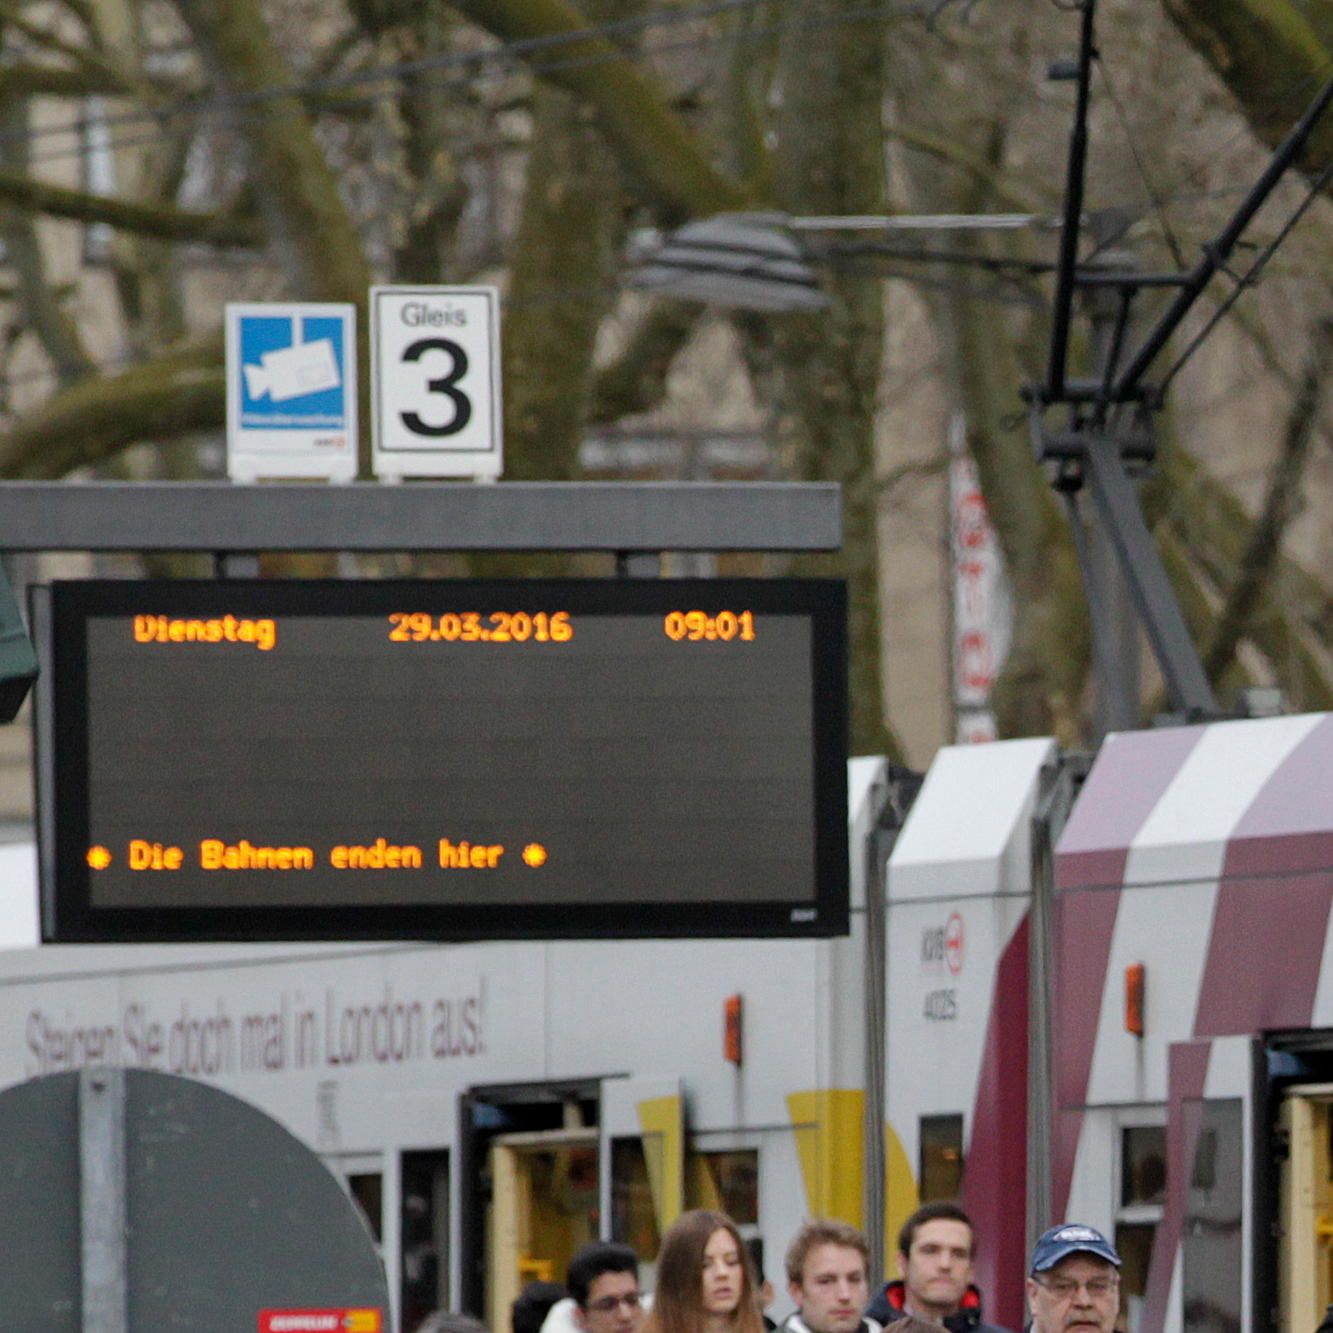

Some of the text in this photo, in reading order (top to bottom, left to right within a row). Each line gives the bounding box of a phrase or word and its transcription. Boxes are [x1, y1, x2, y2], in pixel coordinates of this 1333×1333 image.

[401, 302, 467, 326] Gleis
[399, 337, 472, 437] 3
[132, 610, 756, 651] Dienstag 29.03.2016 09:01
[128, 837, 504, 870] Die Bahnen enden hier
[168, 998, 234, 1074] doch
[240, 988, 287, 1071] mal
[293, 988, 318, 1070] in
[325, 984, 425, 1065] London
[431, 974, 488, 1058] aus!
